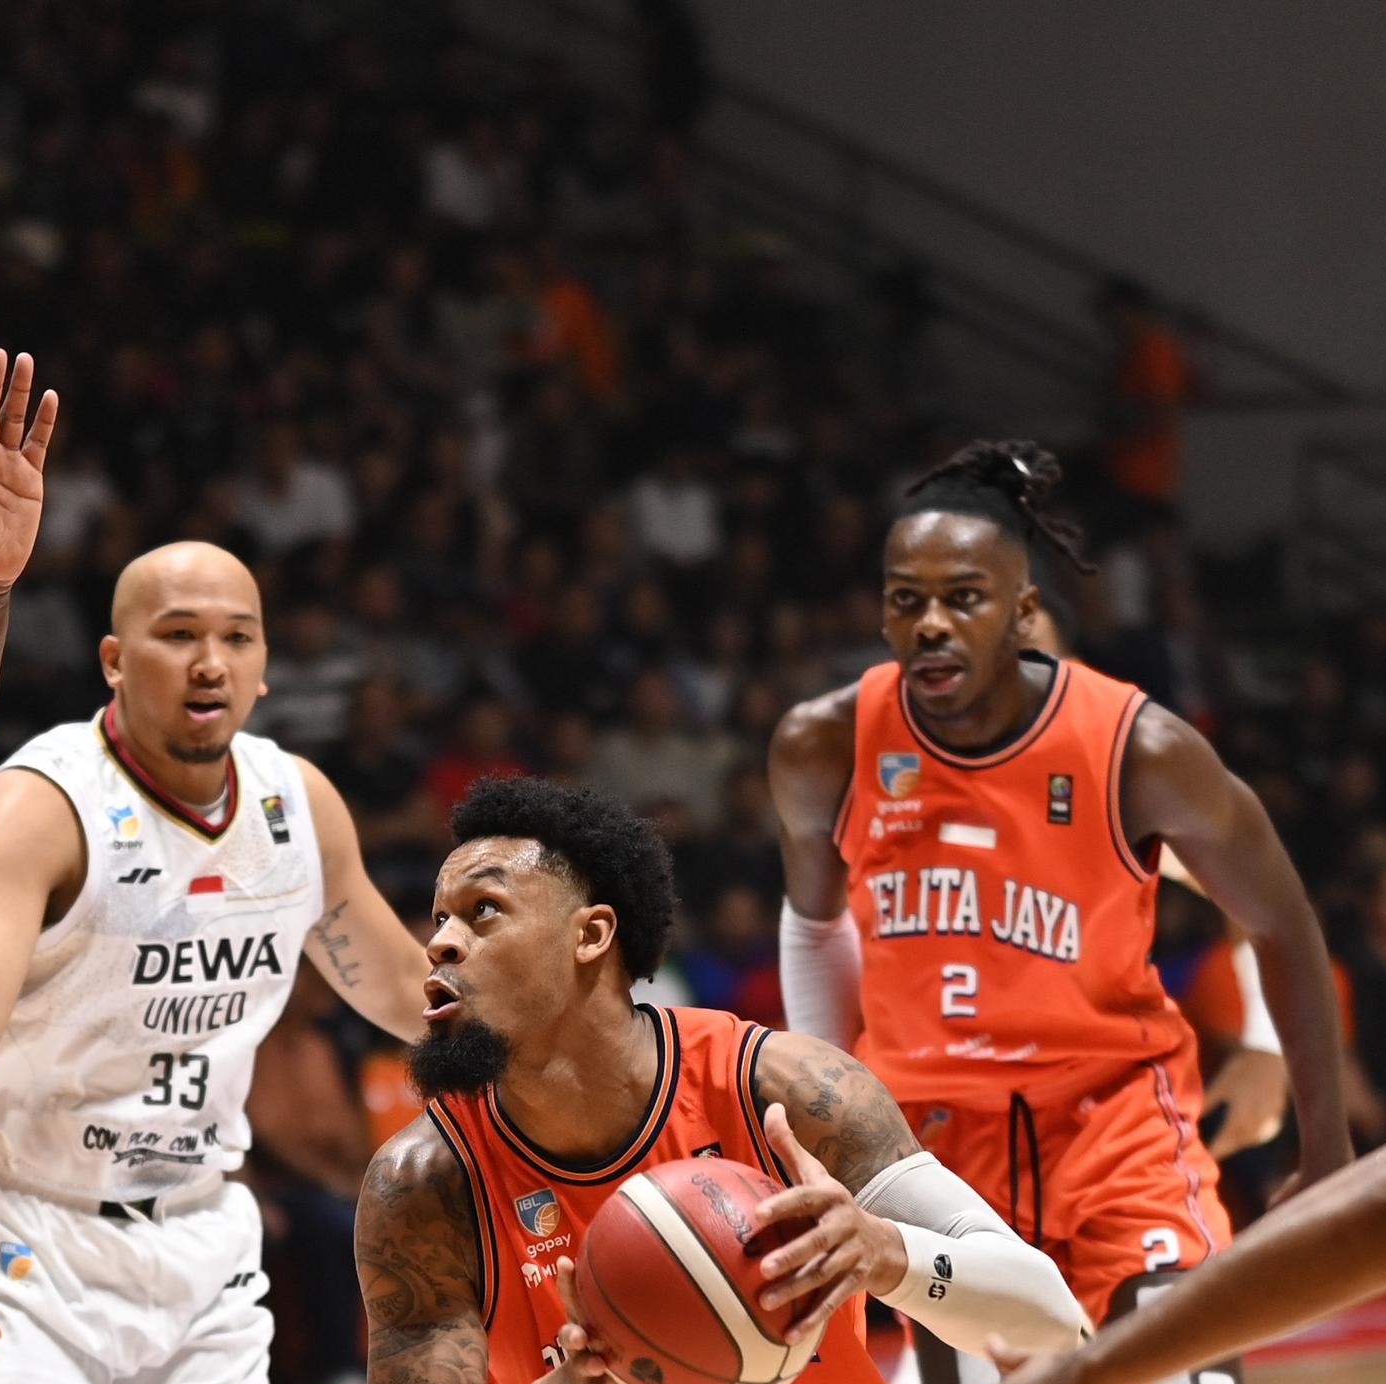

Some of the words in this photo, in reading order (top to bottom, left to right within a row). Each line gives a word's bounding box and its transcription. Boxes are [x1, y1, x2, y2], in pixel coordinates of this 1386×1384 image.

[866, 867, 981, 938] ELITA
[991, 880, 1080, 962] JAYA
[132, 932, 283, 985] DEWA
[940, 962, 980, 1018] 2
[143, 991, 247, 1035] UNITED
[142, 1052, 210, 1110] 33
[83, 1124, 121, 1151] COW
[169, 1135, 199, 1152] COW
[518, 1197, 542, 1212] IBL
[527, 1233, 572, 1258] gopay
[1140, 1226, 1181, 1272] 2
[541, 1263, 558, 1278] MI
